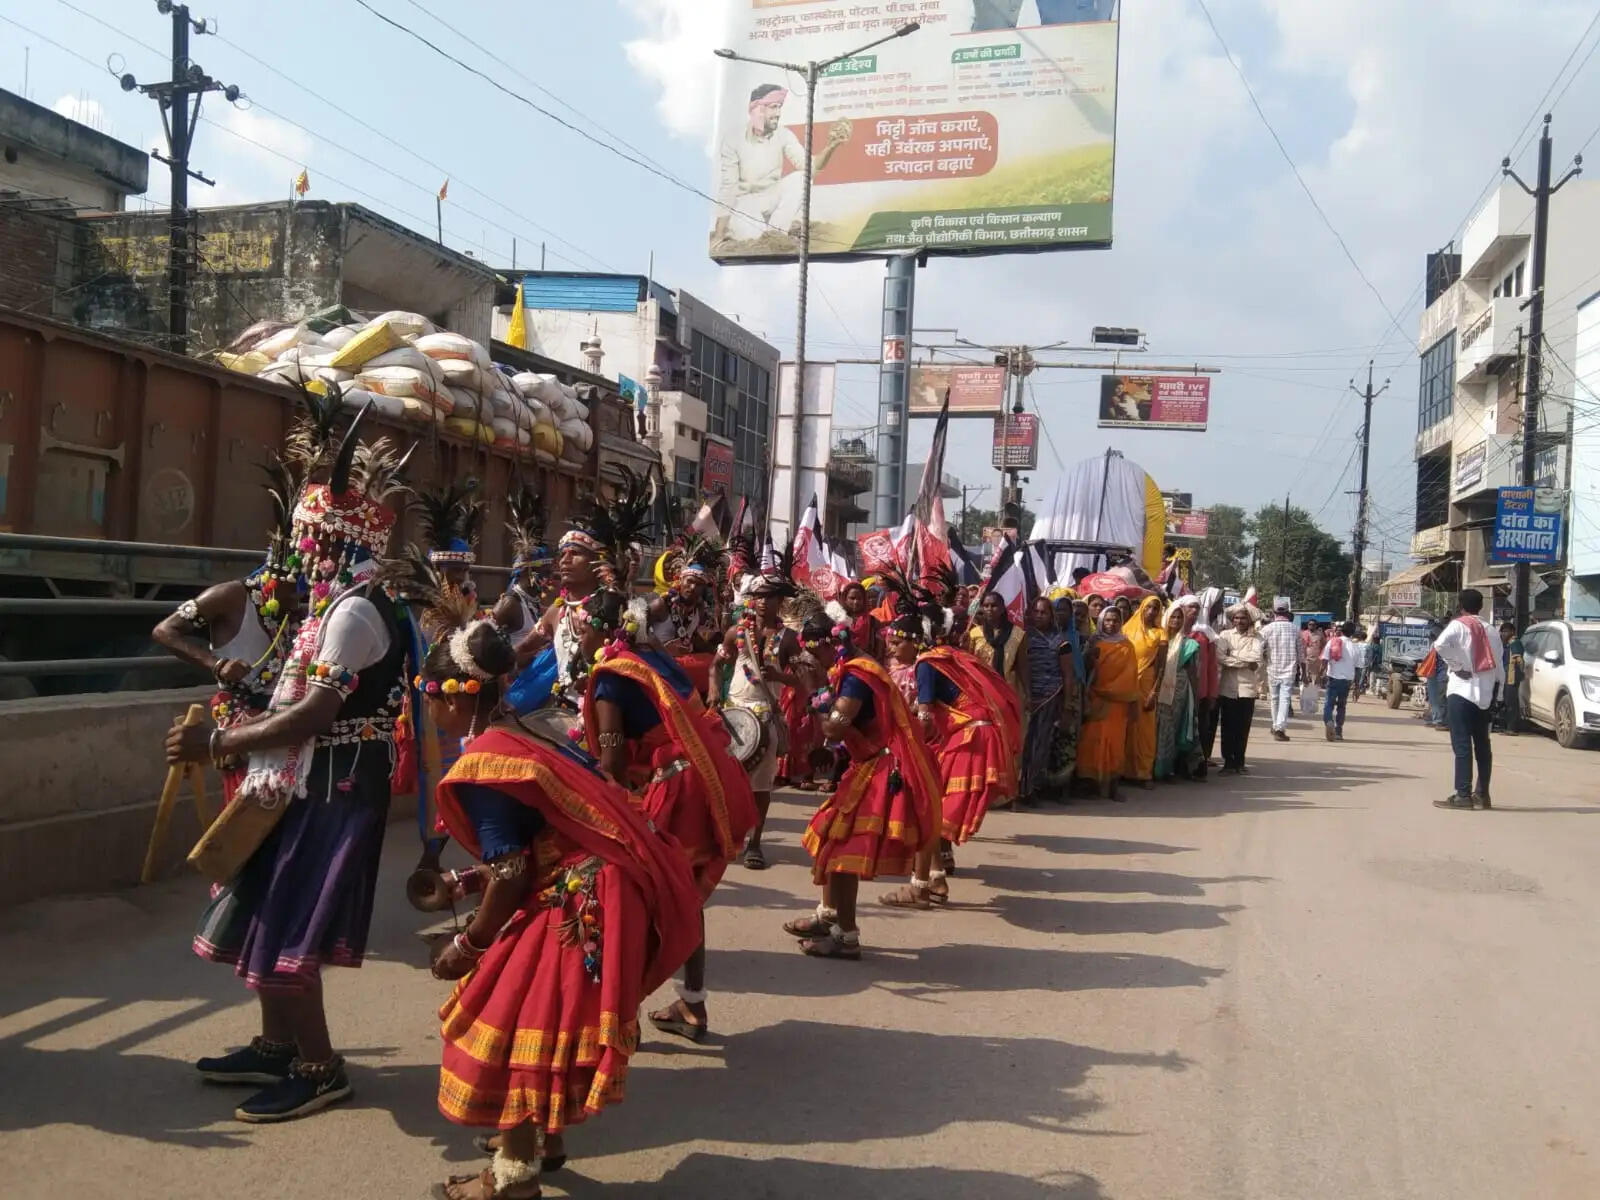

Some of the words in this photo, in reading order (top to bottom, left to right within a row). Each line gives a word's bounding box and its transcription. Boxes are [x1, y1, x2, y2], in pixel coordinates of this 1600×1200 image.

[844, 58, 873, 73] उद्देश्य
[876, 119, 906, 140] मिट्टी
[864, 138, 892, 157] सही
[894, 138, 937, 155] उर्वरक
[884, 159, 935, 175] उत्पादन
[910, 216, 933, 232] कृषि
[934, 214, 968, 228] विकास
[969, 213, 985, 226] एवं
[986, 212, 1021, 225] किसान
[1021, 210, 1063, 224] कल्याण
[885, 233, 905, 244] तथा
[907, 230, 924, 245] जैव
[974, 227, 1008, 241] विभाग,
[1057, 225, 1089, 238] शासन
[1188, 383, 1206, 391] IVF
[1501, 512, 1530, 529] दांत
[1533, 515, 1556, 530] का
[1496, 529, 1556, 550] अस्पताल
